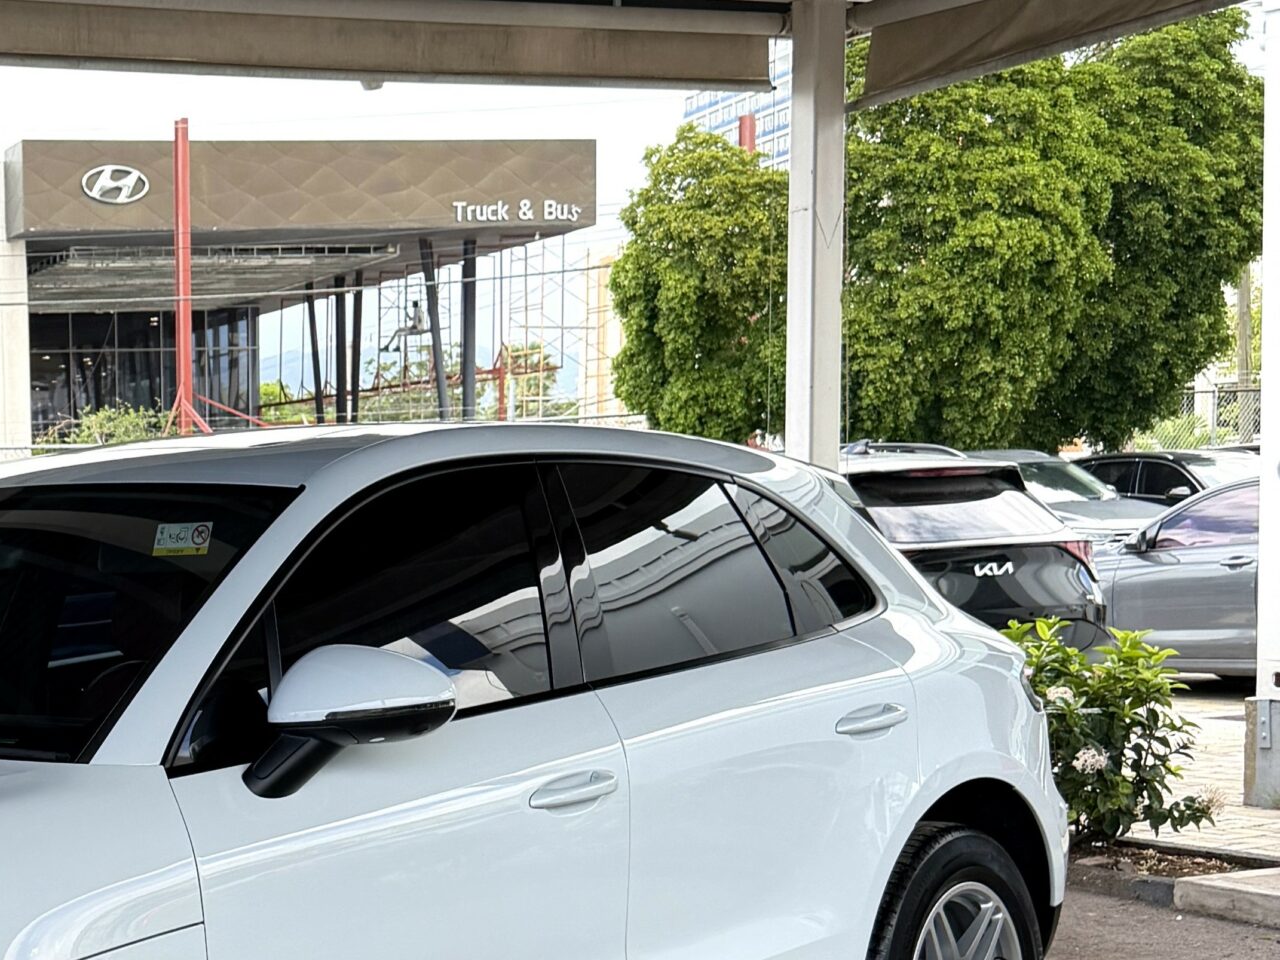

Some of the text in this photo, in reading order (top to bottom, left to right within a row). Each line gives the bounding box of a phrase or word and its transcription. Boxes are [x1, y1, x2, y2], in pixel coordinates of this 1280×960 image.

[452, 199, 583, 222] Truck & Bus
[973, 561, 1014, 577] KIA
